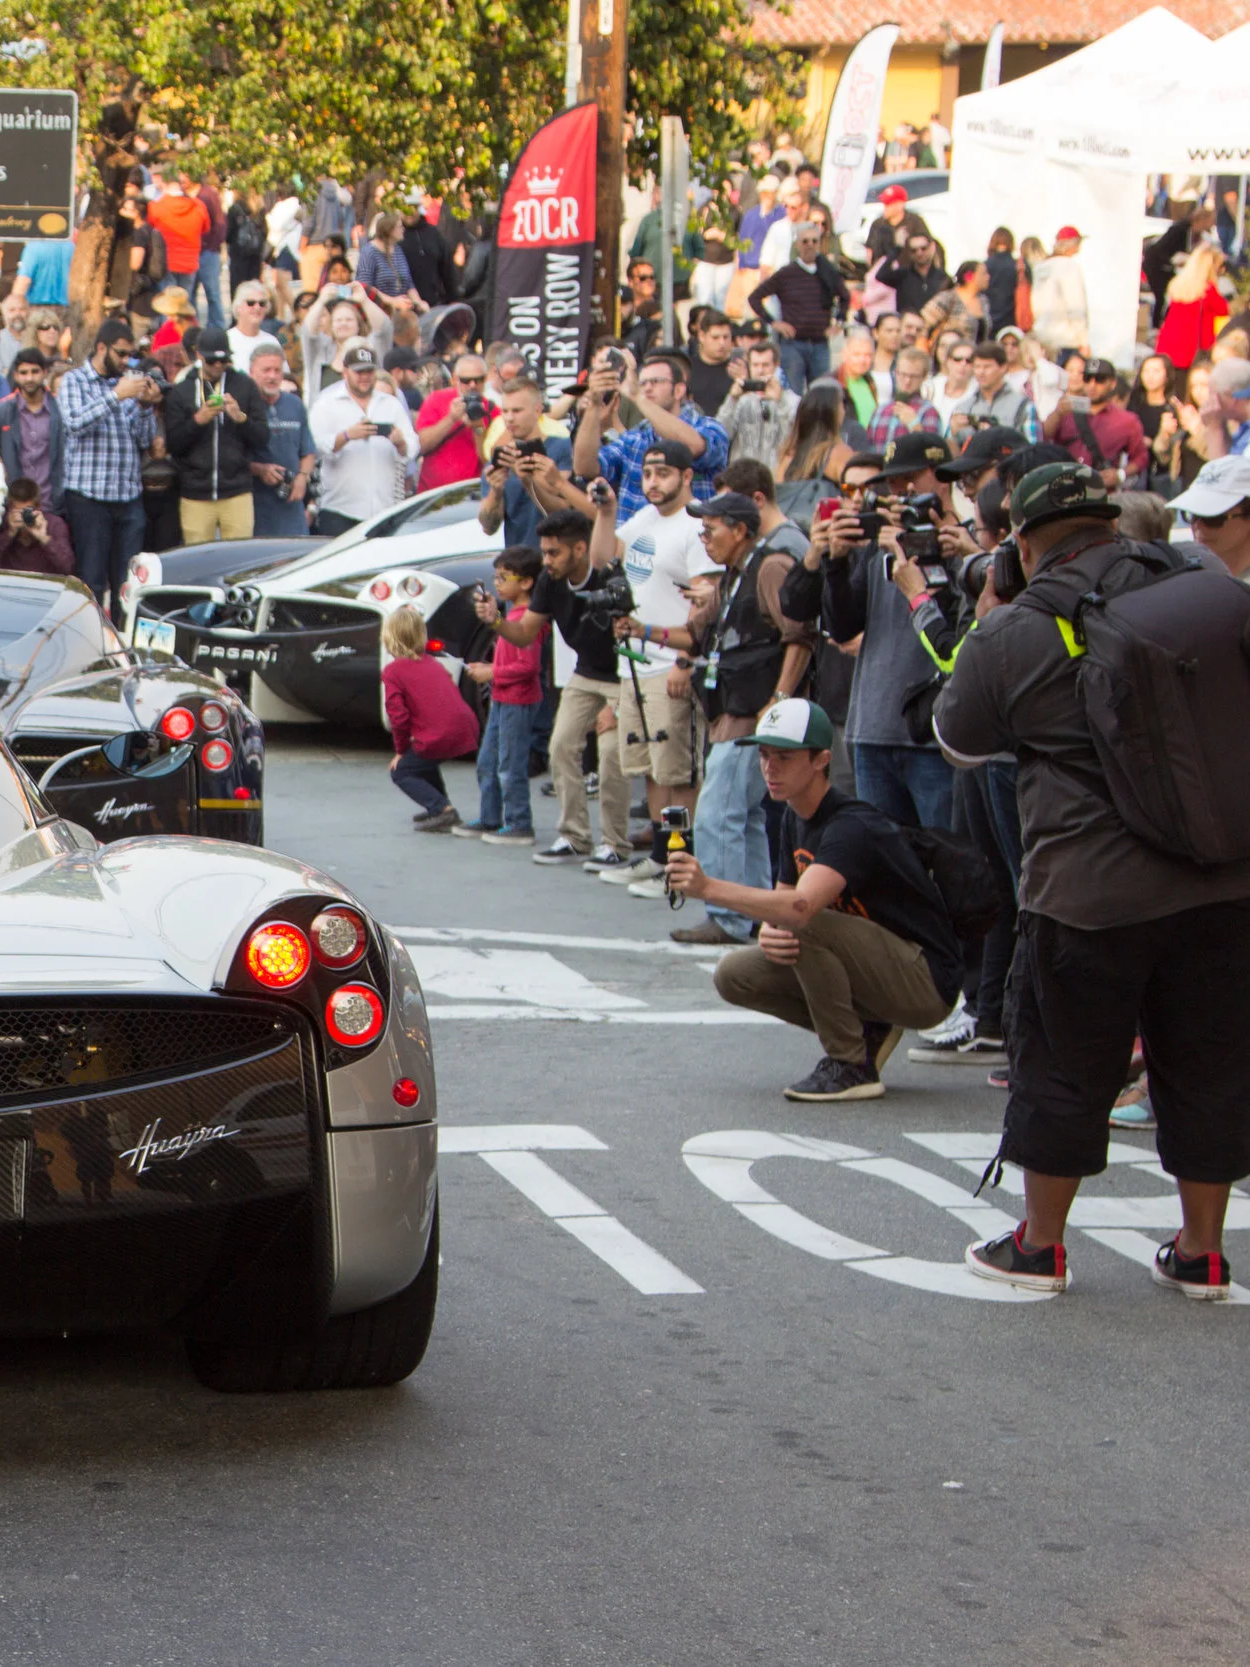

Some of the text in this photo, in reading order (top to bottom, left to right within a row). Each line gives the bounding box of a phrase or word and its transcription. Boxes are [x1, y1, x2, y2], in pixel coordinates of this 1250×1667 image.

[545, 252, 581, 317] ROW
[508, 296, 542, 337] ON
[198, 643, 278, 663] PAGANI
[94, 796, 156, 825] Huayra
[118, 1117, 241, 1177] Huayra
